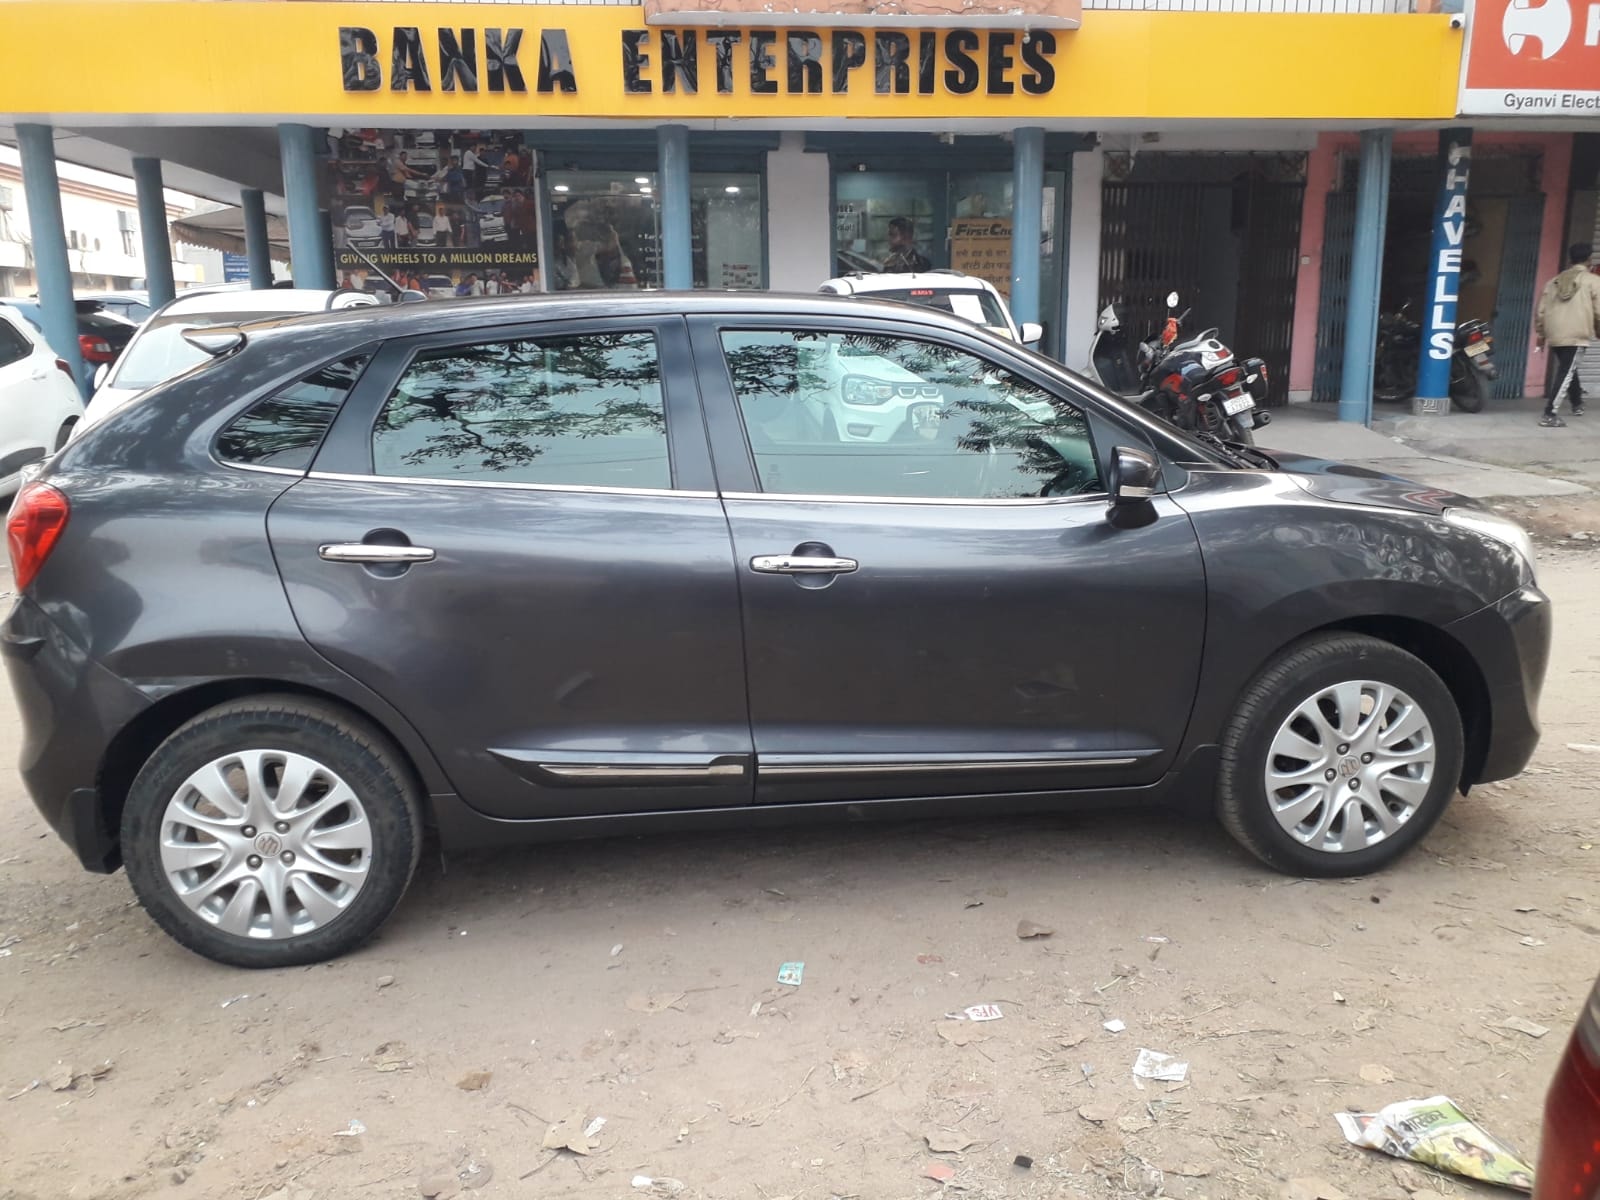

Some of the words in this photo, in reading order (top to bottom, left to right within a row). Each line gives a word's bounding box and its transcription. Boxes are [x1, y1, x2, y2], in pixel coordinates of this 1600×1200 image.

[338, 27, 577, 93] BANKA
[621, 29, 1057, 95] ENTERPRISES
[1503, 92, 1557, 110] Gyanvi
[380, 253, 420, 264] WHEELS
[422, 253, 436, 264] TO
[439, 253, 448, 264] A
[450, 253, 492, 264] MILLION
[494, 253, 537, 264] DREAMS
[1428, 169, 1470, 360] HAVELLS
